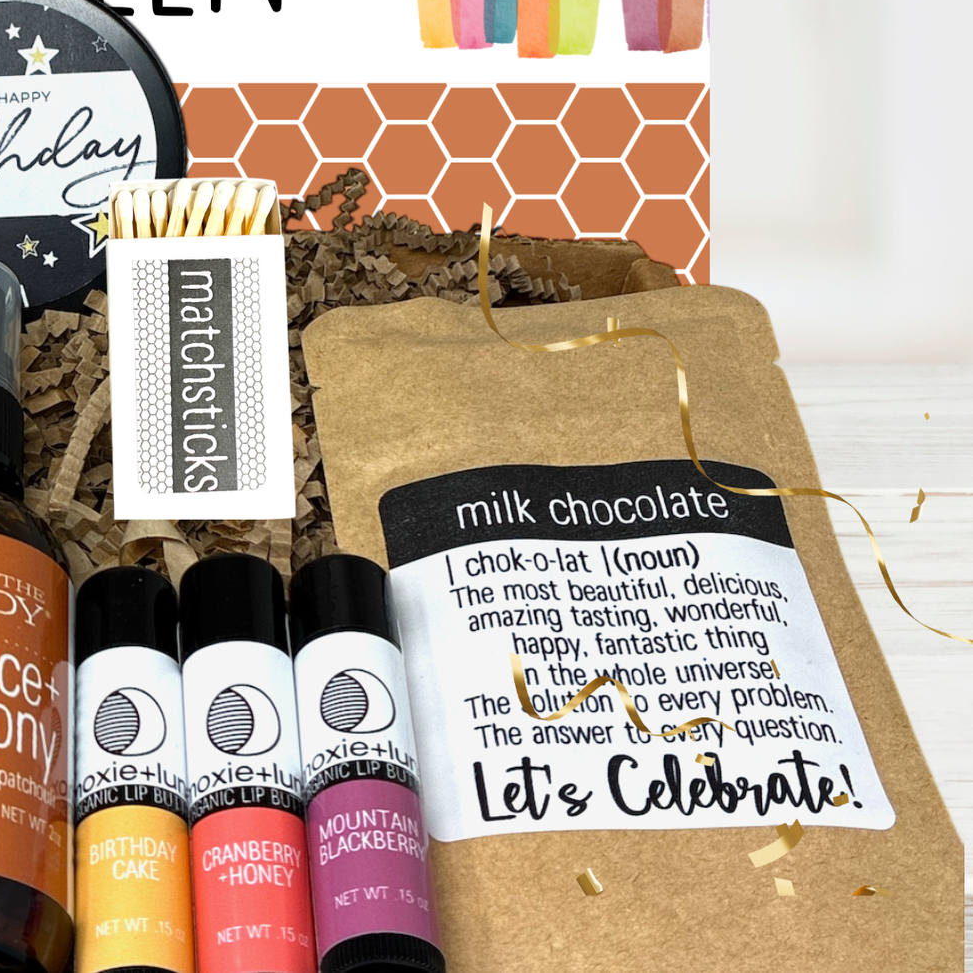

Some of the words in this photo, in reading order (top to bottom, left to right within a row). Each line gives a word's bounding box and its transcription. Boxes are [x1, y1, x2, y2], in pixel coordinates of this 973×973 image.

[180, 270, 229, 493] matchsticks
[456, 490, 536, 529] milk
[548, 485, 729, 527] chocolate
[465, 546, 592, 577] chok-o-lat
[449, 585, 495, 609] The
[503, 580, 561, 601] most
[567, 576, 676, 601] beautiful,
[683, 572, 788, 603] delicious,
[468, 604, 563, 632] amazing
[570, 604, 658, 633] tasting,
[664, 598, 787, 627] wonderful,
[512, 632, 589, 661] happy,
[595, 629, 698, 655] fantastic
[705, 625, 770, 656] thing
[548, 662, 587, 686] the
[594, 662, 667, 687] whole
[464, 693, 511, 719] The
[522, 688, 614, 713] olution
[659, 690, 721, 715] every
[731, 683, 834, 714] problem.
[474, 723, 523, 749] The
[532, 725, 615, 746] answer
[624, 721, 652, 744] to
[661, 722, 723, 748] every
[735, 717, 843, 747] question.
[355, 760, 381, 777] LIP
[124, 785, 148, 801] LIP
[241, 787, 264, 804] LIP
[473, 756, 593, 822] Let's
[608, 749, 863, 818] Celebrate!
[0, 804, 25, 823] NET
[29, 815, 46, 834] WT
[319, 809, 419, 844] MOUNTAIN
[89, 837, 177, 865] BIRTHDAY
[203, 840, 300, 871] CRANBERRY
[319, 830, 425, 866] BLACKBERRY
[112, 859, 160, 881] CAKE
[218, 863, 294, 887] +HONEY
[334, 888, 359, 910] NET
[363, 886, 389, 900] WT
[96, 918, 120, 938] NET
[124, 917, 149, 934] WT
[217, 926, 242, 945] NET
[246, 924, 271, 939] WT
